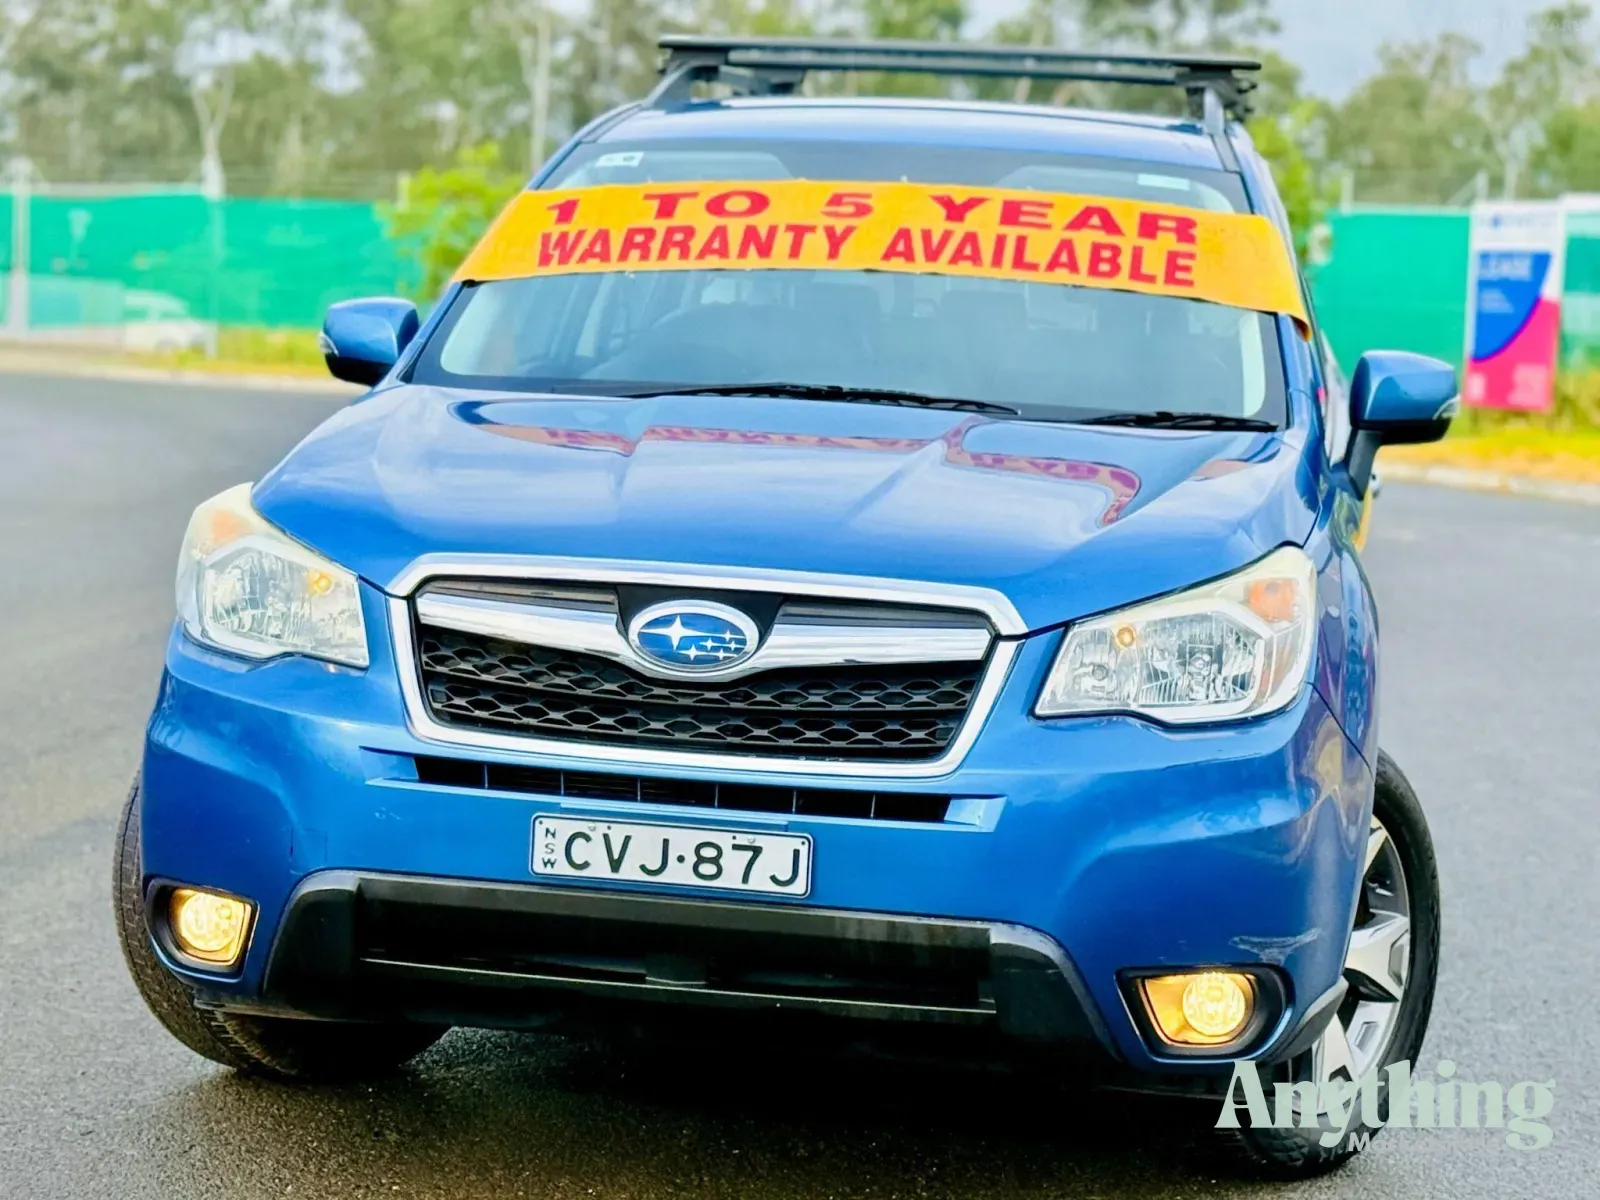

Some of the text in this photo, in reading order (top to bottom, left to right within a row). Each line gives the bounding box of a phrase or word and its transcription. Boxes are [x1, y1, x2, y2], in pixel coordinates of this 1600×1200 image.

[547, 190, 1198, 246] 1 TO 5 YEAR
[537, 224, 1198, 289] WARRANTY AVAILABLE
